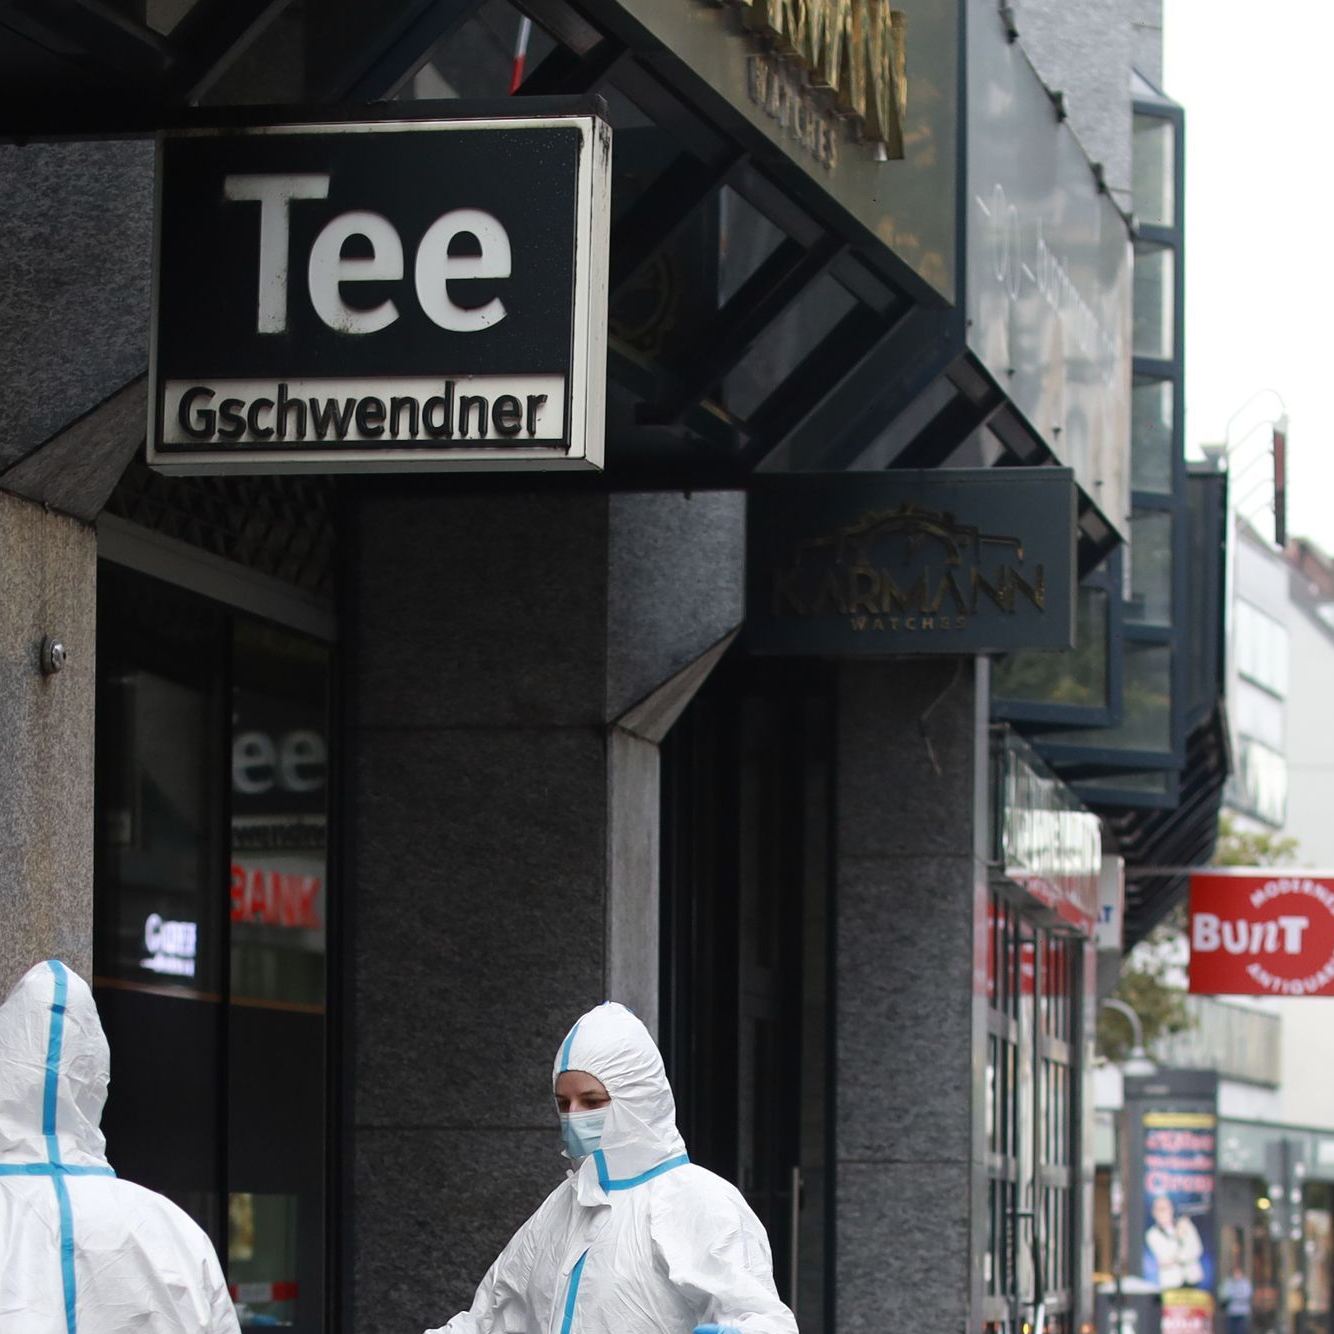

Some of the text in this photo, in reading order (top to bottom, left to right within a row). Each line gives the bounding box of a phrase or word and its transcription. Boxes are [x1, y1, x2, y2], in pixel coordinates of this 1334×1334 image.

[223, 173, 513, 335] Tee
[178, 380, 548, 439] Gschwendner
[851, 616, 967, 632] WATCHES
